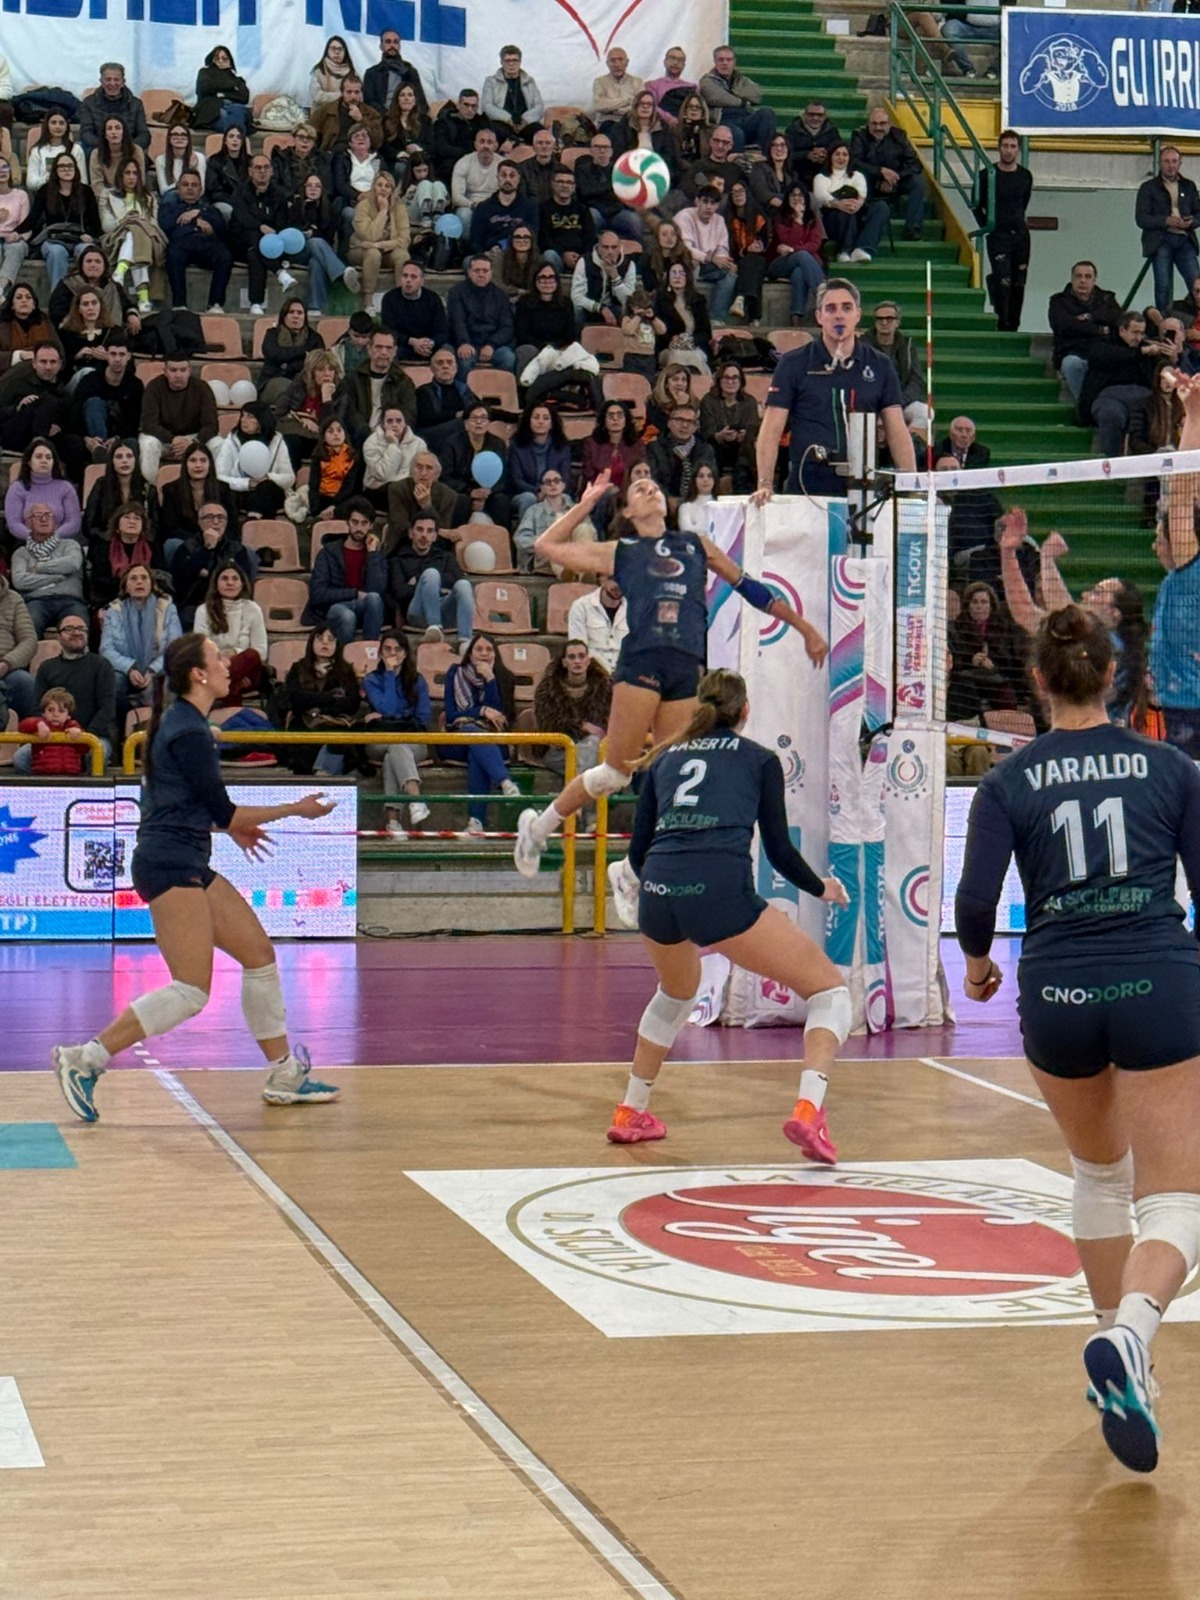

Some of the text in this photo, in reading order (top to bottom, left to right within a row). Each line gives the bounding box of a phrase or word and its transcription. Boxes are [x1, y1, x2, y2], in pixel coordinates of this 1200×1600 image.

[1111, 37, 1149, 107] GLI
[654, 538, 671, 557] 6
[673, 758, 707, 807] 2
[1024, 753, 1148, 792] VARALDO
[1050, 796, 1128, 882] 11
[1065, 886, 1153, 905] SICILFERT
[542, 1227, 674, 1273] SICILIA
[663, 1190, 1068, 1284] Sigel
